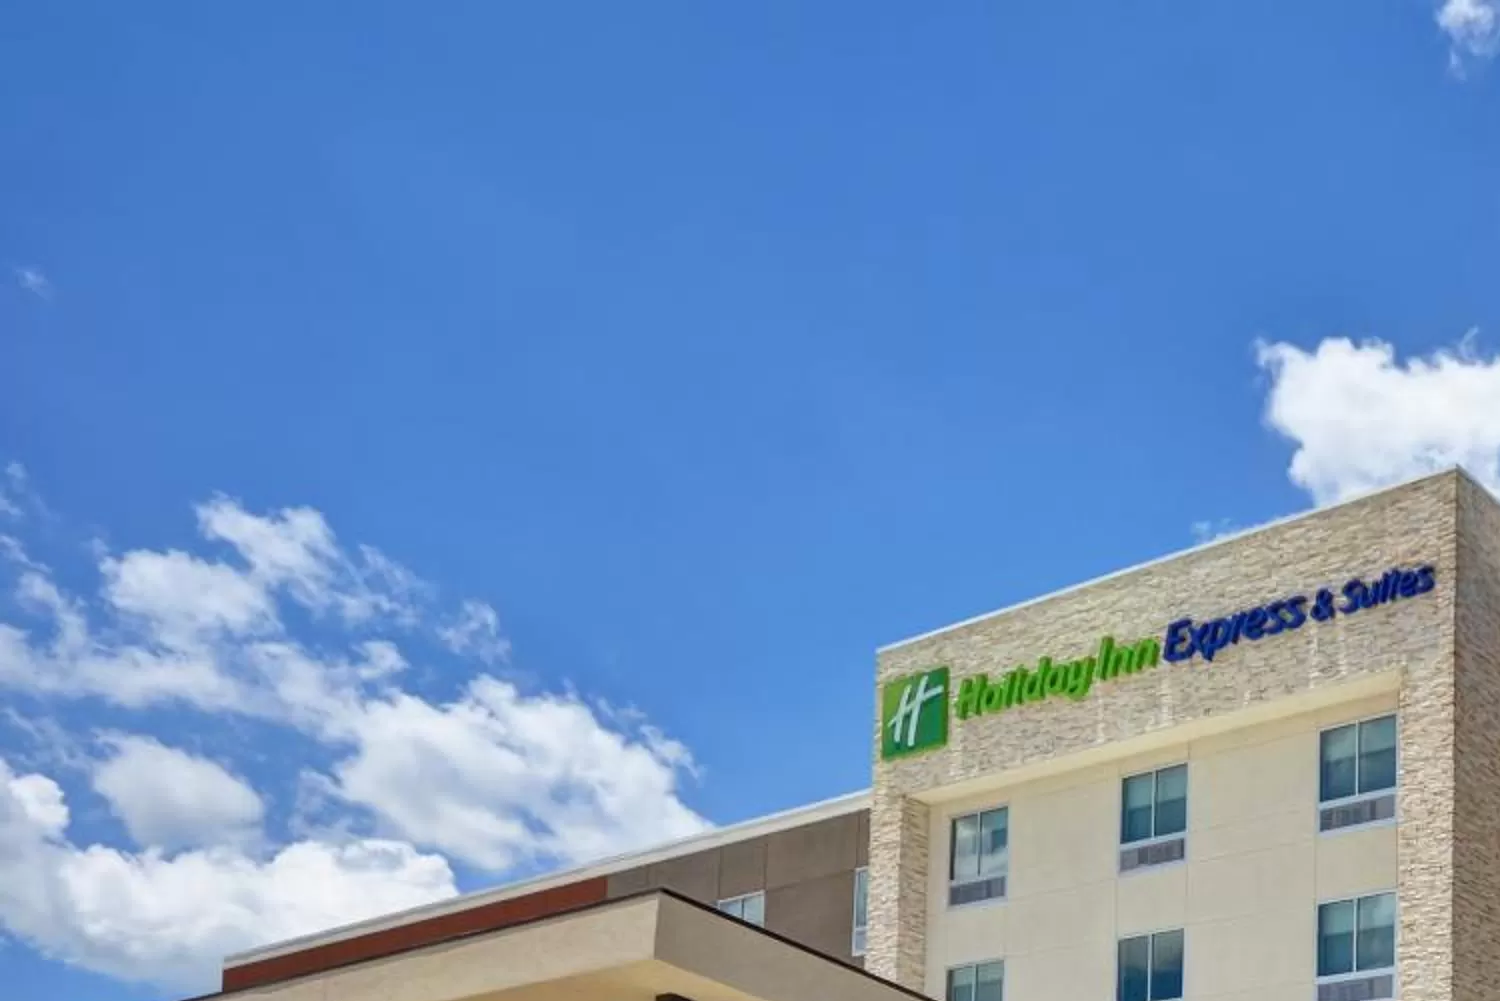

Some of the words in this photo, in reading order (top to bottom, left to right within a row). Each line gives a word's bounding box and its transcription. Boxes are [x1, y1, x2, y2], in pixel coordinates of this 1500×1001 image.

[956, 655, 1096, 720] Holiday
[1095, 636, 1160, 681] Inn
[1163, 596, 1308, 662] Express
[1310, 588, 1336, 622] &
[1339, 565, 1436, 614] Suites
